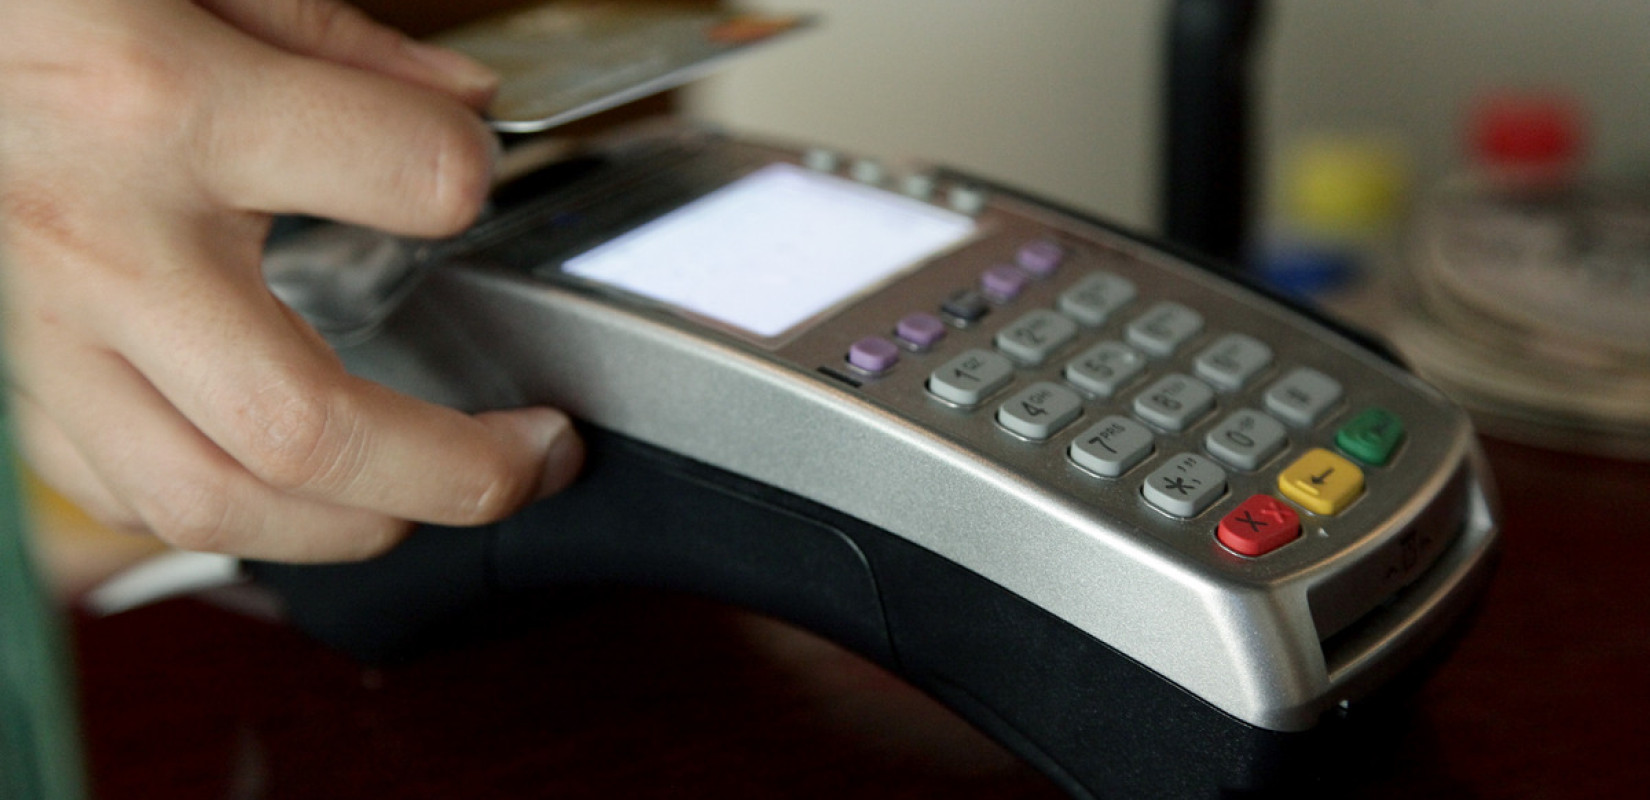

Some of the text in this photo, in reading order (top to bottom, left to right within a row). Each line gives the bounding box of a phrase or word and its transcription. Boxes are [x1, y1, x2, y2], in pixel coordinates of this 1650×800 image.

[954, 367, 981, 383] 1
[1020, 400, 1048, 417] 4
[1088, 436, 1118, 455] 7
